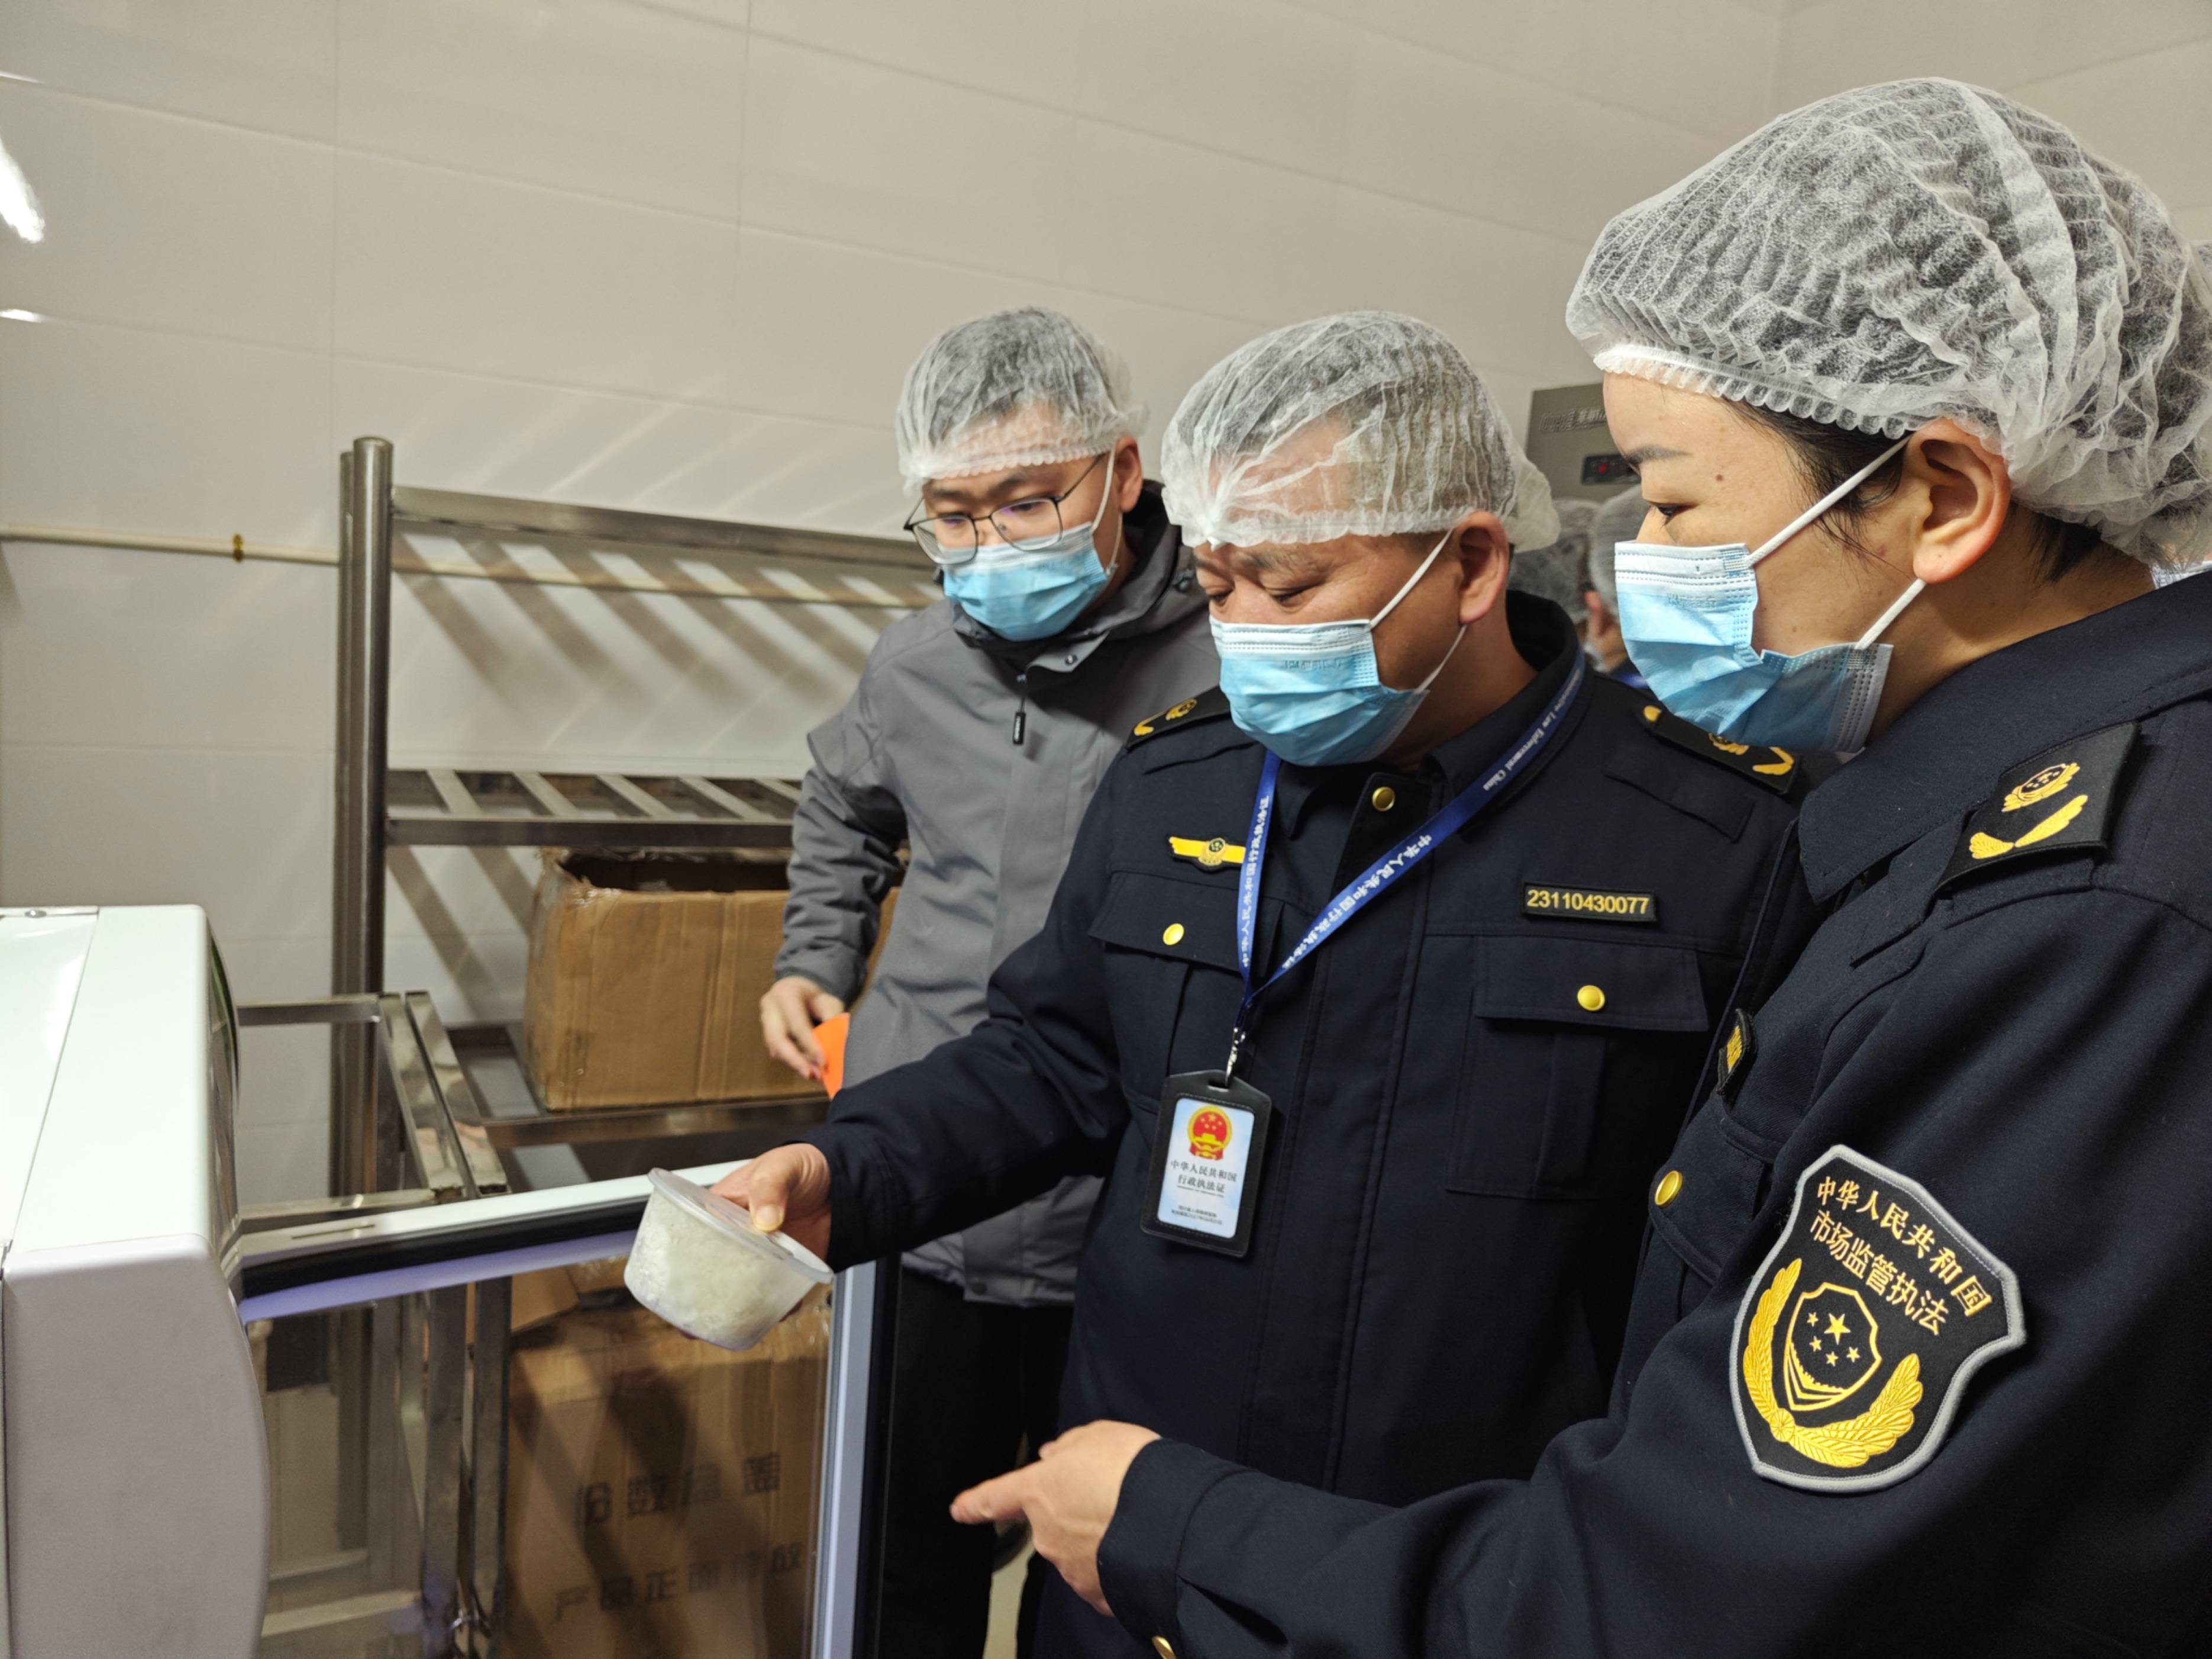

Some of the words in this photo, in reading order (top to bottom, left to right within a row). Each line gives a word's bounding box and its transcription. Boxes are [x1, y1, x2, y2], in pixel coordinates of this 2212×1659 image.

[1483, 769, 1506, 790] China
[1527, 890, 1649, 914] 23110430077
[1171, 1160, 1237, 1182] 中华人民共和国
[1177, 1174, 1225, 1193] 行政执法证
[1817, 1176, 1993, 1317] 中华人民共和国
[1810, 1210, 1949, 1335] 市场监管执法
